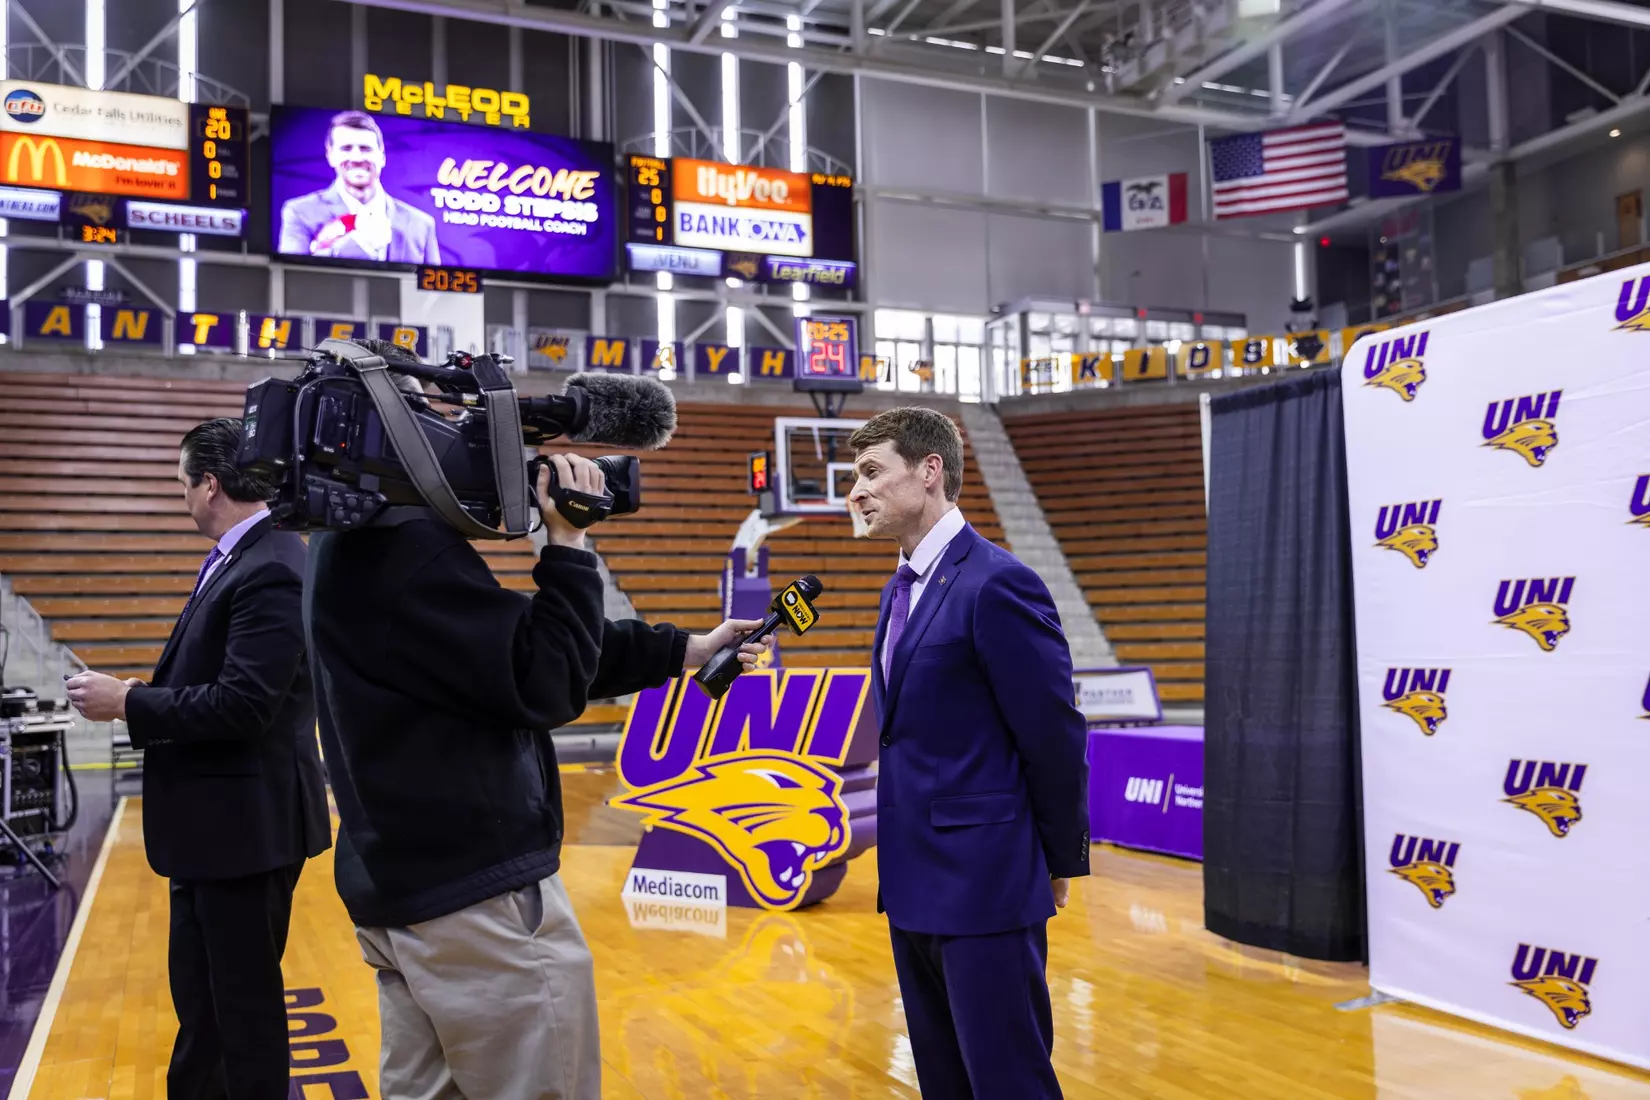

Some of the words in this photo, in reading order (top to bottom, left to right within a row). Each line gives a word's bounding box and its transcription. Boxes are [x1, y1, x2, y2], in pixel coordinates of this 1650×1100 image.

[364, 74, 530, 117] McLEOD
[53, 101, 92, 117] Cedar
[97, 107, 126, 121] Falls
[129, 110, 183, 128] Utilities
[365, 96, 530, 129] CENTER
[205, 119, 231, 140] 20
[72, 150, 180, 177] McDonald's
[637, 167, 660, 186] 25
[437, 157, 600, 200] WELCOME
[430, 187, 501, 213] TODD
[131, 208, 236, 230] SCHEELS
[443, 211, 479, 226] HEAD
[480, 214, 543, 232] FOOTBALL
[543, 219, 587, 235] COACH
[680, 212, 740, 237] BANK
[421, 268, 478, 292] 20:25
[771, 260, 847, 284] Learfield
[811, 342, 845, 373] 24
[1363, 330, 1430, 380] UNI
[1482, 388, 1564, 440] UNI
[568, 499, 590, 512] Canon
[1374, 498, 1442, 541] UNI
[1493, 576, 1576, 618] UNI
[792, 604, 808, 626] NOW
[1382, 668, 1452, 702] UNI
[616, 668, 872, 788] UNI
[1125, 776, 1163, 805] UNI
[1503, 759, 1588, 797] UNI
[1389, 833, 1461, 868] UNI
[633, 874, 719, 901] Mediacom
[1511, 943, 1598, 986] UNI
